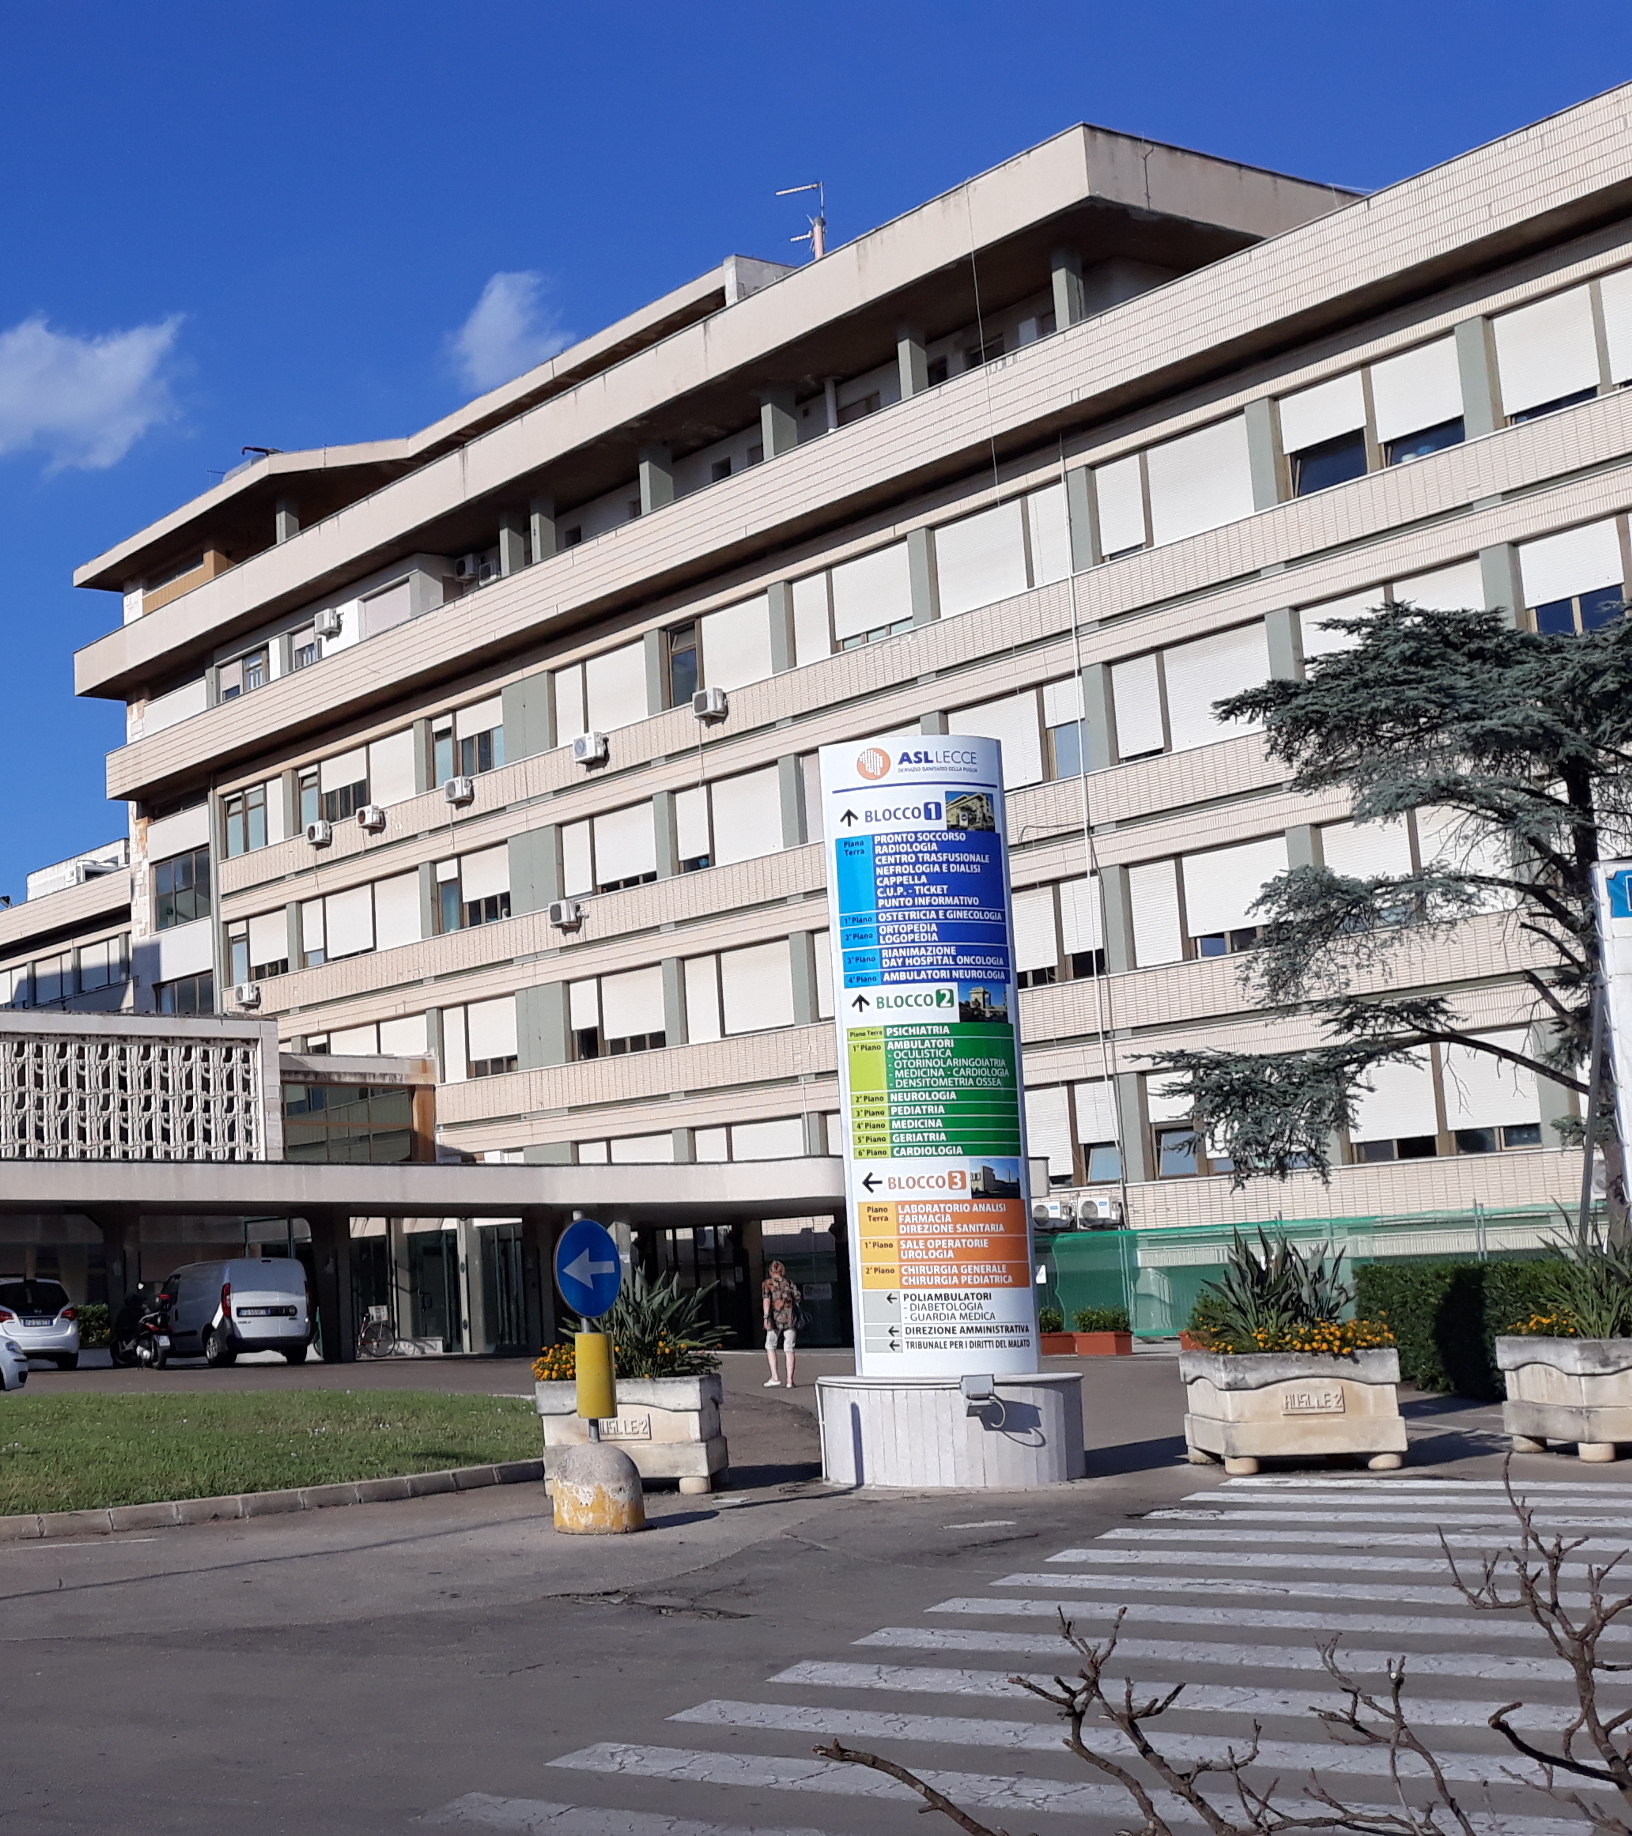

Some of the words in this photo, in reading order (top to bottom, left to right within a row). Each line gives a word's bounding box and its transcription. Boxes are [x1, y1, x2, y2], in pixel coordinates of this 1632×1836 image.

[898, 751, 934, 765] ASL
[936, 751, 976, 764] LECCE
[865, 807, 921, 823] BLOCCO
[928, 804, 937, 819] 1
[875, 834, 915, 844] PRONTO
[917, 832, 966, 841] SOCCORSO
[844, 840, 864, 848] Piano
[875, 842, 938, 854] RADIOLOGIA
[875, 854, 915, 865] CENTRO
[919, 853, 990, 863] TRASFUSIONALE
[876, 865, 940, 875] NEFROLOGIA
[950, 864, 981, 873] DIALISI
[877, 875, 927, 886] CAPPELLA
[877, 886, 907, 897] C.U.P.
[914, 885, 948, 894] TICKET
[878, 898, 913, 908] PUNTO
[915, 897, 979, 906] INFORMATIVO
[852, 916, 872, 924] Piano
[879, 910, 937, 921] OSTETRICIA
[939, 911, 944, 919] E
[947, 910, 1002, 921] GINECOLOGIA
[879, 923, 937, 934] ORTOPEDIA
[853, 932, 873, 940] Piano
[880, 933, 938, 944] LOGOPEDIA
[882, 946, 956, 957] RIANIMAZIONE
[883, 958, 903, 968] DAY
[906, 957, 954, 966] HOSPITAL
[957, 955, 1004, 965] ONCOLOGIA
[856, 975, 877, 983] Piano
[883, 970, 950, 982] AMBULATORI
[952, 969, 1005, 980] NEUROLOGIA
[877, 993, 933, 1009] BLOCCO
[940, 990, 951, 1007] 2
[886, 1025, 950, 1036] PSICHIATRIA
[887, 1039, 955, 1050] AMBULATORI
[893, 1049, 952, 1059] OCULISTICA
[894, 1058, 1006, 1068] OTORINOLARINGOIATRIA
[894, 1068, 945, 1078] MEDICINA
[953, 1068, 1010, 1077] CARDIOLOGIA
[895, 1078, 974, 1088] DENSITOMETRIA
[976, 1077, 1002, 1086] OSSEA
[890, 1091, 957, 1101] NEUROLOGIA
[891, 1105, 945, 1115] PEDIATRIA
[891, 1119, 943, 1129] MEDICINA
[892, 1132, 947, 1143] GERIATRIA
[893, 1146, 963, 1156] CARDIOLOGIA
[888, 1175, 946, 1190] BLOCCO
[952, 1172, 961, 1188] 3
[898, 1203, 970, 1213] LABORATORIO
[972, 1203, 1006, 1211] ANALISI
[898, 1214, 952, 1224] FARMACIA
[899, 1224, 954, 1234] DIREZIONE
[956, 1223, 1004, 1232] SANITARIA
[900, 1239, 925, 1249] SALE
[927, 1239, 989, 1248] OPERATORIE
[900, 1250, 954, 1259] UROLOGIA
[901, 1265, 958, 1274] CHIRURGIA
[961, 1264, 1007, 1274] GENERALE
[902, 1275, 959, 1285] CHIRURGIA
[961, 1274, 1013, 1284] PEDIATRICA
[903, 1292, 992, 1302] POLIAMBULATORI
[910, 1303, 983, 1312] DIABETOLOGIA
[910, 1312, 956, 1321] GUARDIA
[959, 1312, 996, 1321] MEDICA
[905, 1326, 957, 1335] DIREZIONE
[960, 1325, 1030, 1334] AMMINISTRATIVA
[906, 1341, 948, 1349] TRIBUNALE
[950, 1341, 963, 1349] PER
[965, 1341, 967, 1349] I
[970, 1340, 994, 1348] DIRITTI
[996, 1340, 1007, 1348] DEL
[1008, 1340, 1030, 1348] MALATO
[598, 1420, 623, 1435] USL
